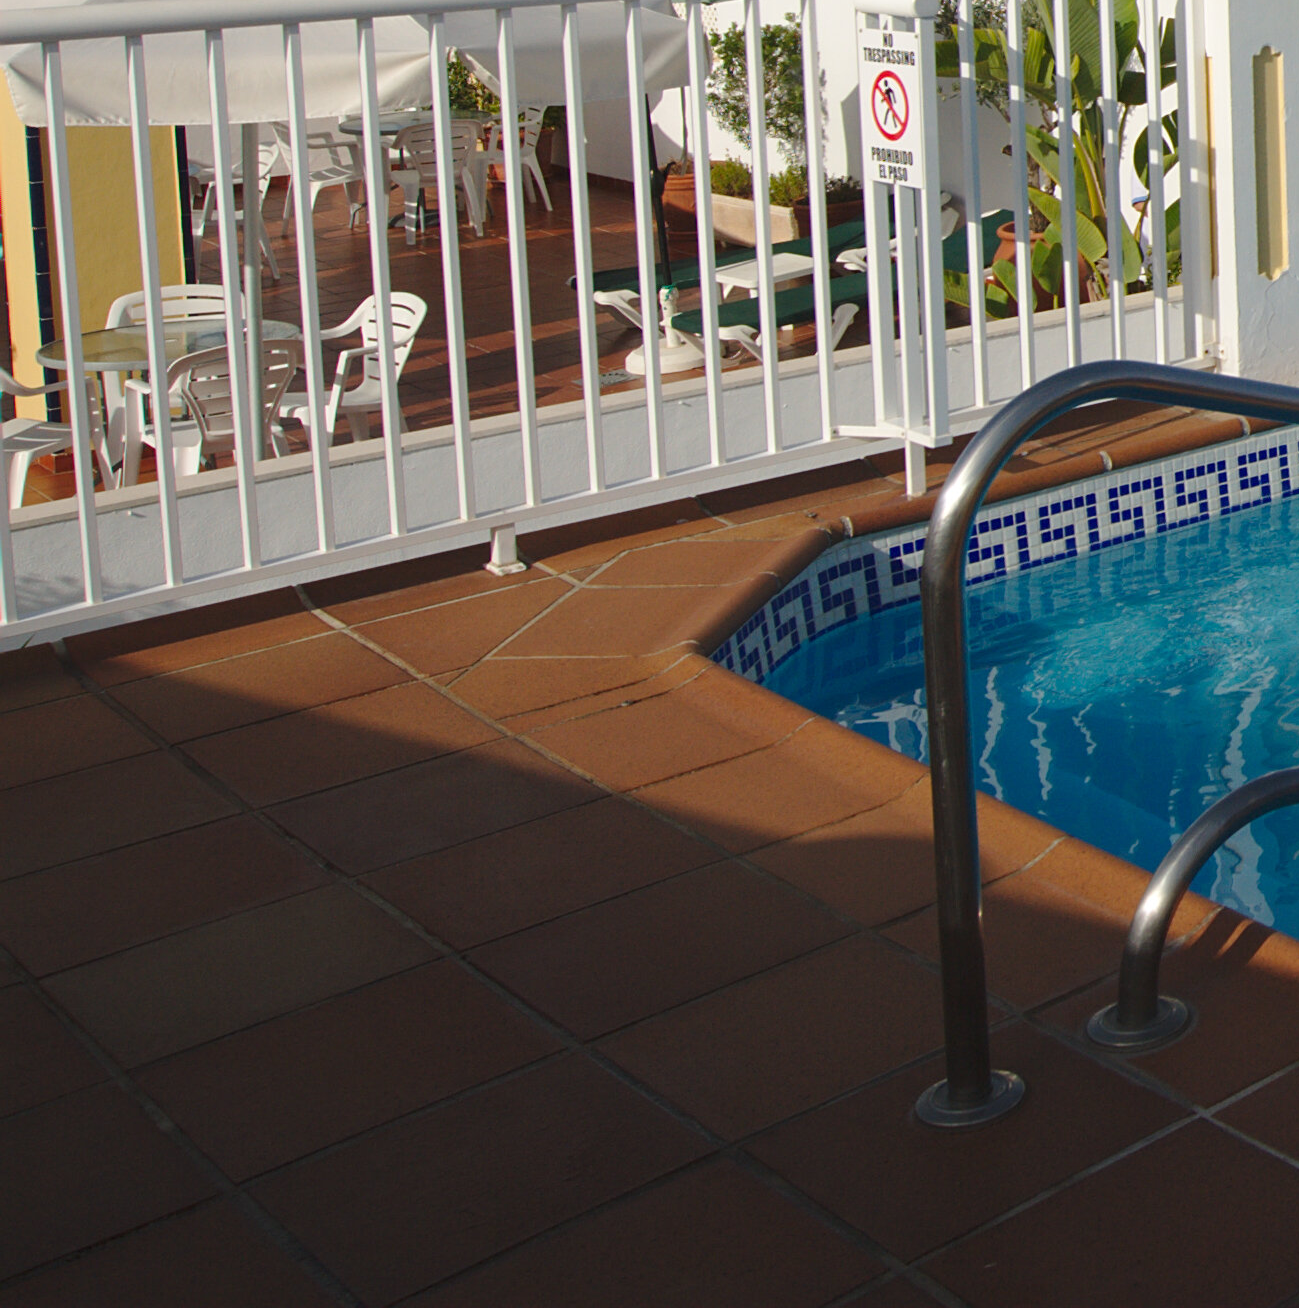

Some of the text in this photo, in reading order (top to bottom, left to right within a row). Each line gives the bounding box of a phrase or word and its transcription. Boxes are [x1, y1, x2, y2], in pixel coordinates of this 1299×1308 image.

[882, 33, 894, 48] NO
[863, 47, 915, 66] TRESPASSING
[871, 147, 913, 166] PROHIBIDO
[879, 164, 908, 182] EL PASO
